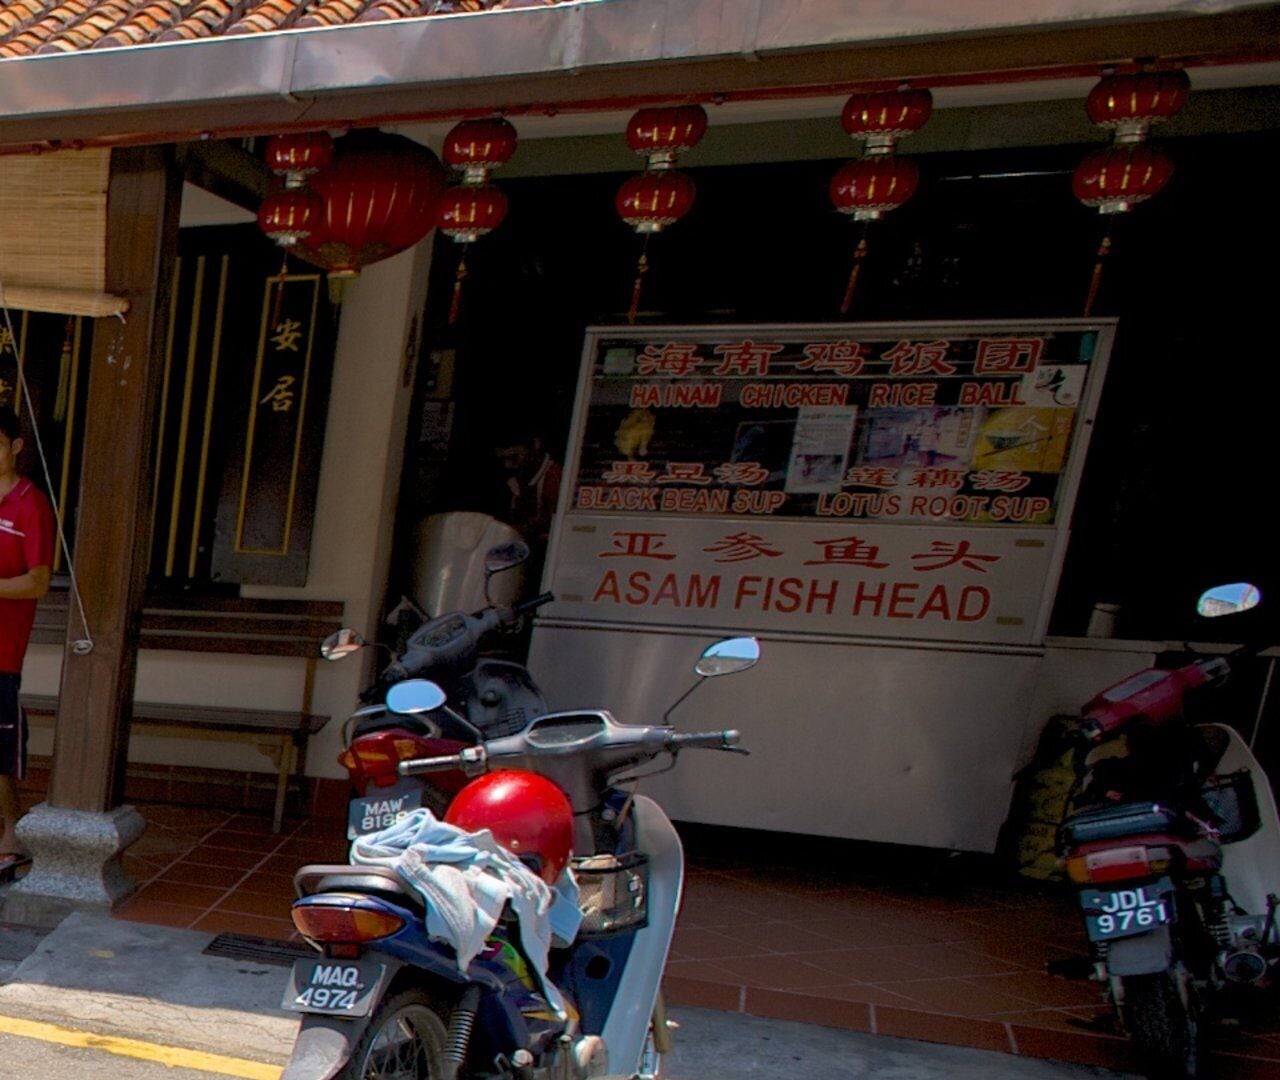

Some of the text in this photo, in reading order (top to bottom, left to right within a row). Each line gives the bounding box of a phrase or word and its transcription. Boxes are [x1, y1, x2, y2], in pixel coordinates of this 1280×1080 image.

[637, 338, 1044, 377] 海南鸡饭团
[630, 383, 722, 407] HAINAM
[740, 383, 849, 407] CHICKEN
[869, 383, 938, 407] RICE
[959, 382, 1026, 406] BALL
[578, 486, 1050, 521] BLACK BEAN SUP LOTUS ROOT SUP
[598, 531, 1000, 573] 亚参鱼头
[593, 570, 992, 623] ASAM FISH HEAD
[365, 798, 403, 817] MAW
[1101, 888, 1157, 913] JDL
[1098, 904, 1166, 933] 9761
[312, 965, 358, 987] MAQ
[296, 988, 357, 1010] 4974
